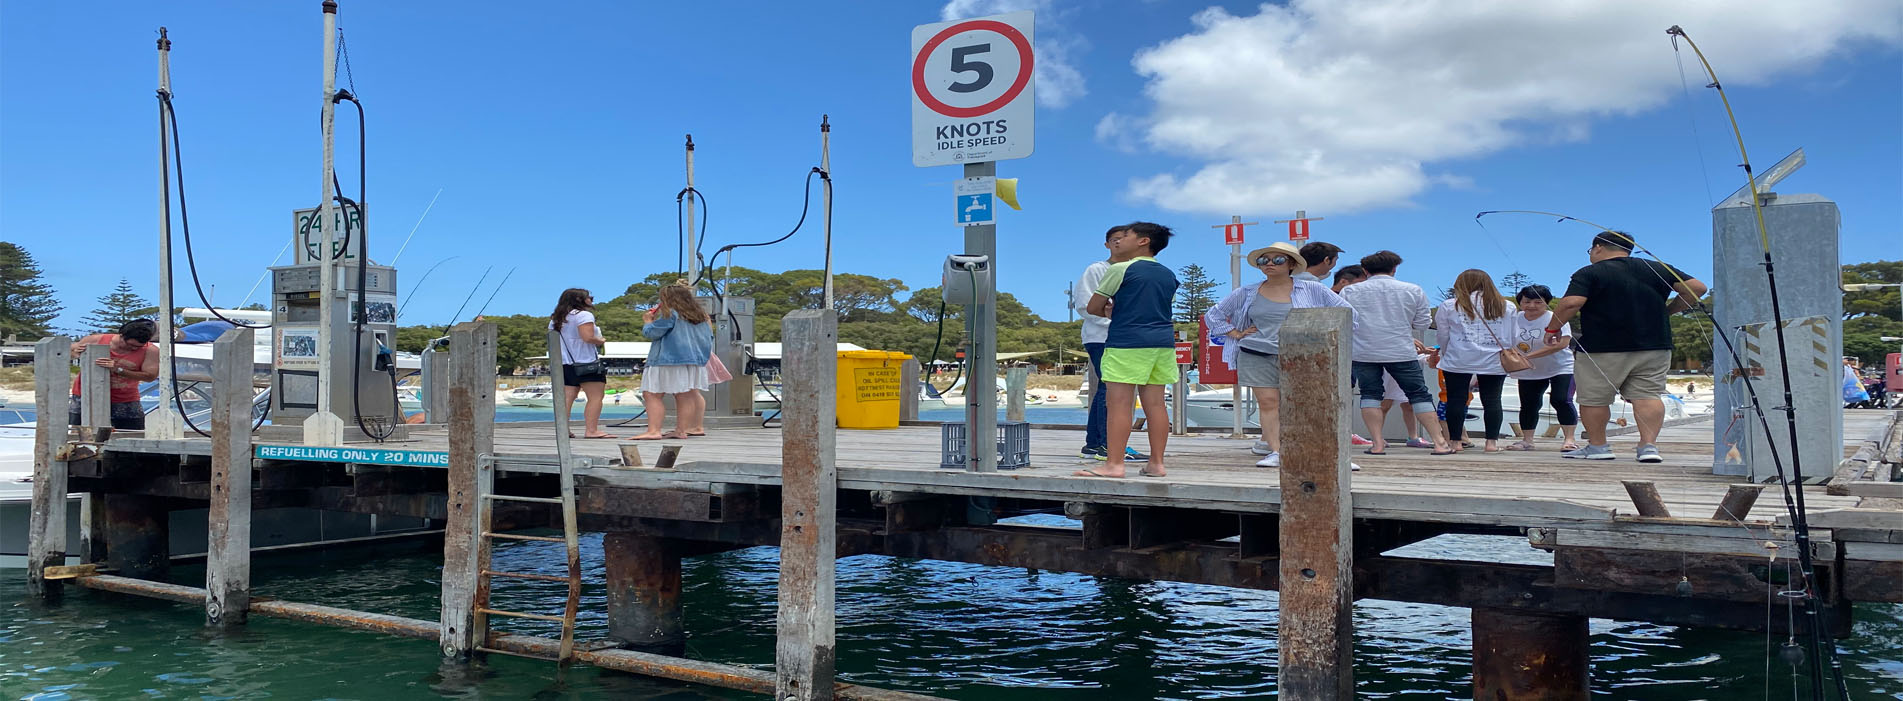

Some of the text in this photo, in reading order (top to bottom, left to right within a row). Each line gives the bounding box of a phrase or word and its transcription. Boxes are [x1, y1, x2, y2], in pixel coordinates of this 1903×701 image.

[947, 43, 994, 93] 5
[936, 119, 1008, 140] KNOTS
[937, 135, 1007, 150] IDLE SPEED
[307, 241, 355, 261] FEL
[261, 447, 449, 464] REFUELLING ONLY 20 MINS
